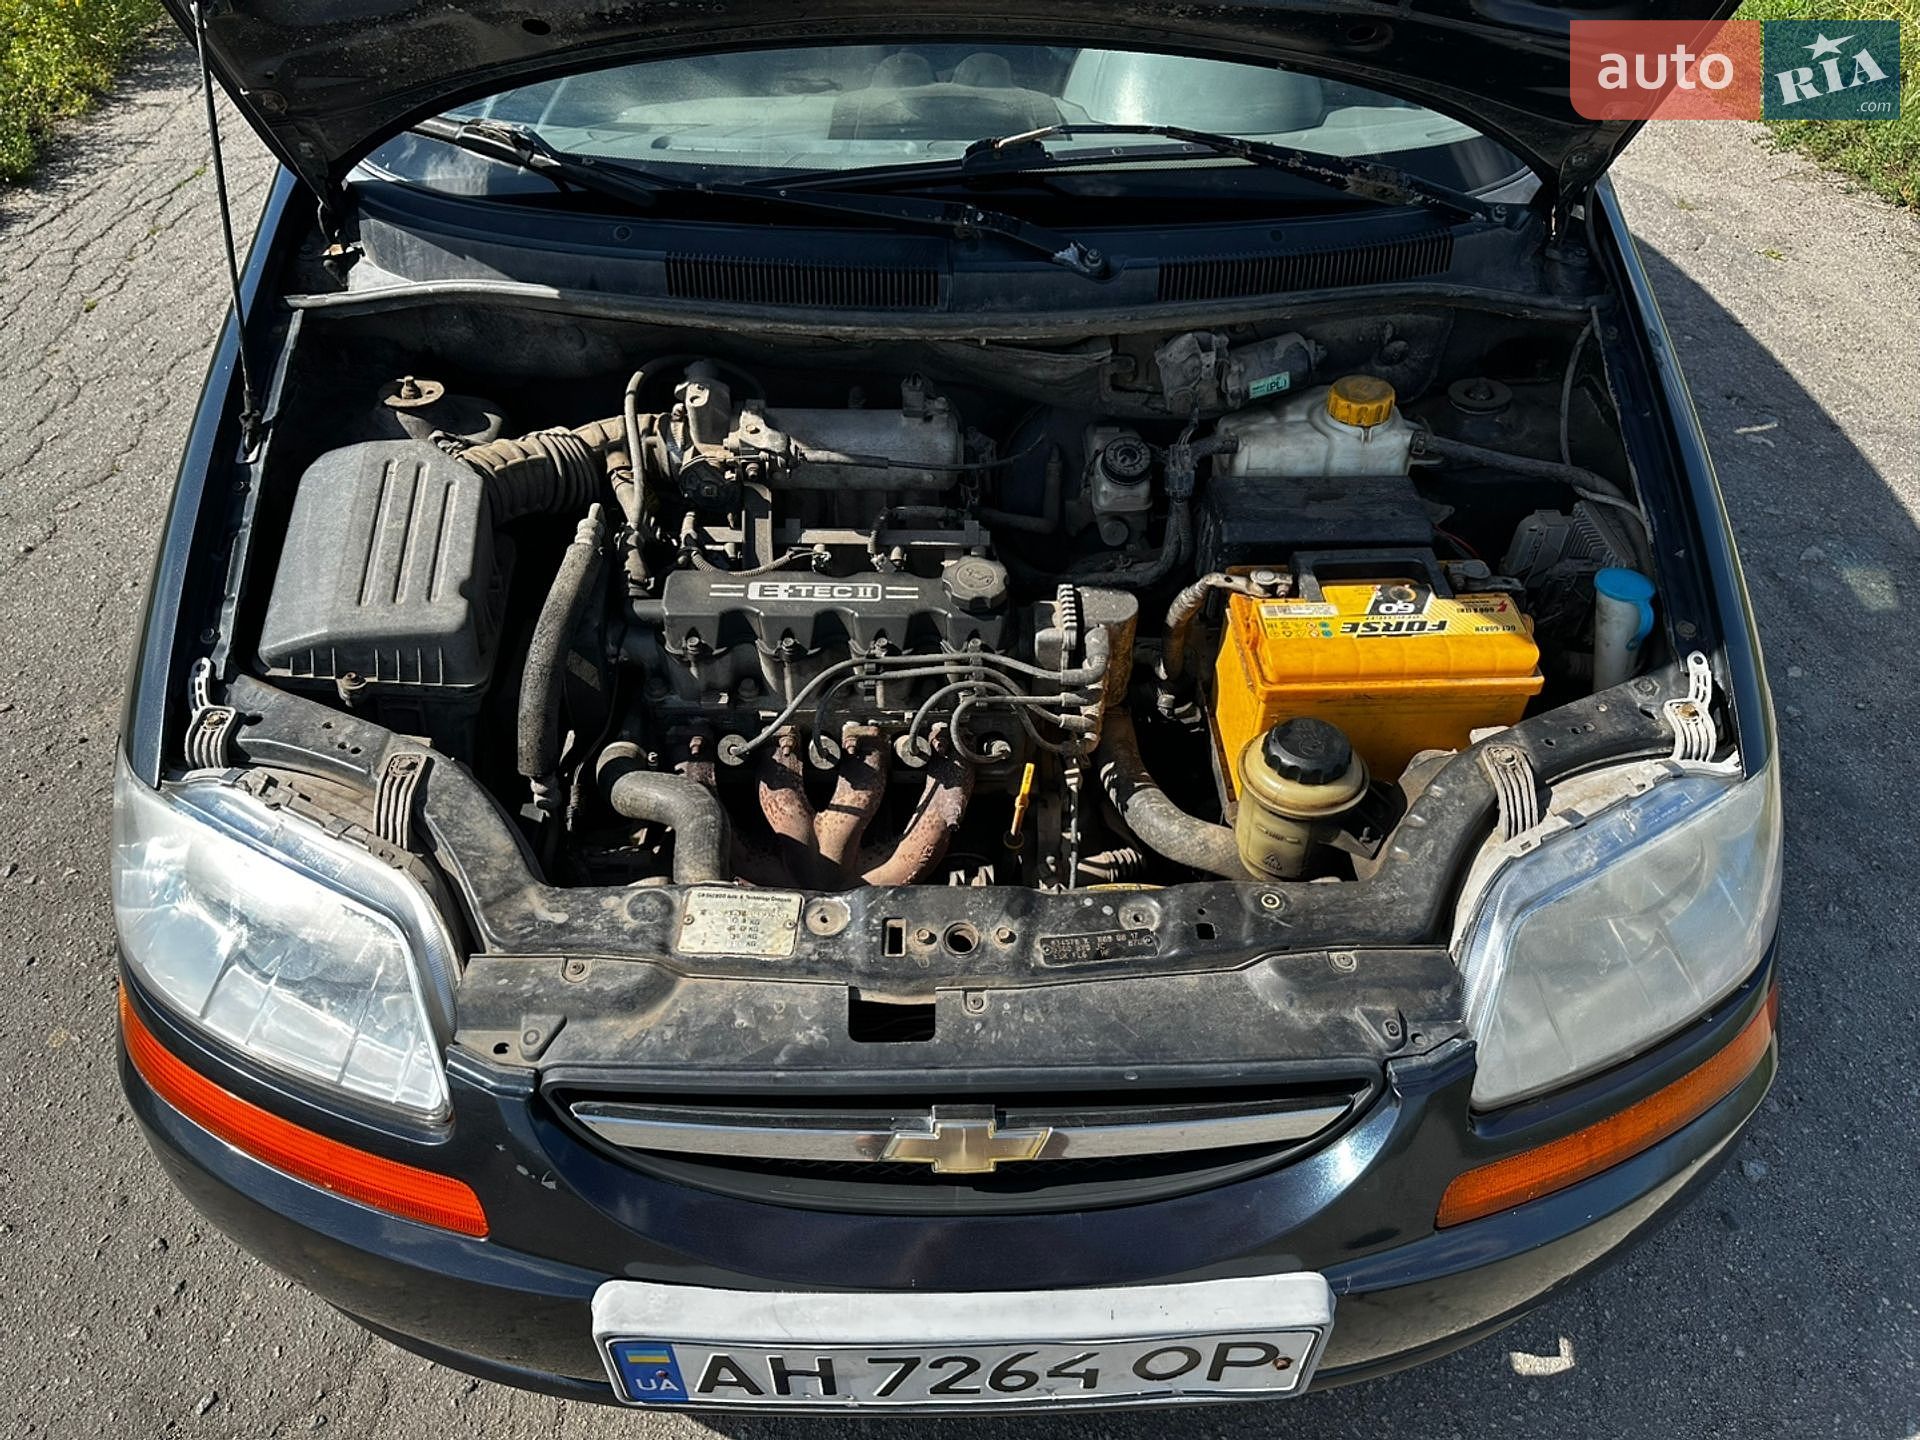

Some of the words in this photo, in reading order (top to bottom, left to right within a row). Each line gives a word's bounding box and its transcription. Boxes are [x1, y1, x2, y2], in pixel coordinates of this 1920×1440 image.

[1378, 602, 1415, 614] 60
[1340, 620, 1448, 634] FORSE
[695, 1353, 837, 1395] AH
[867, 1350, 1099, 1397] 7264
[1132, 1341, 1280, 1382] OP
[636, 1378, 679, 1392] UA
